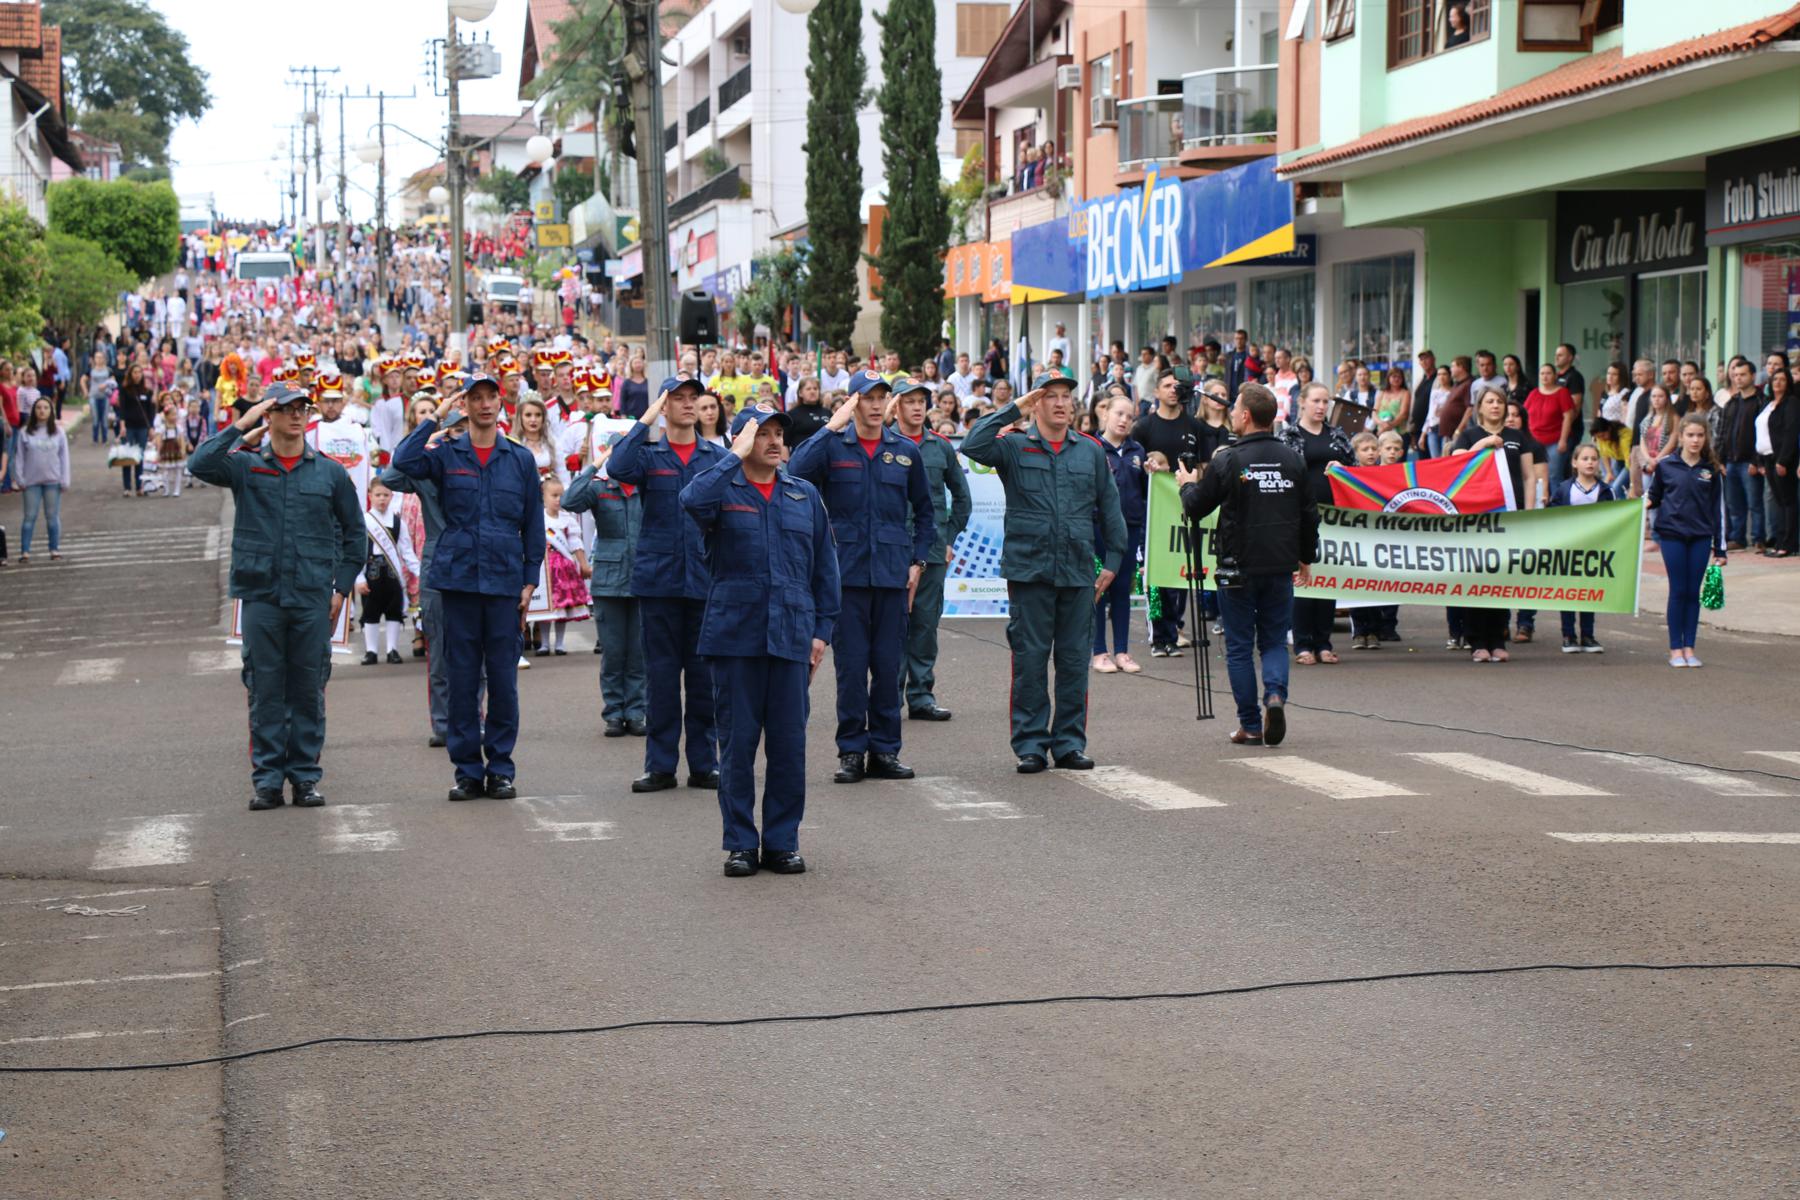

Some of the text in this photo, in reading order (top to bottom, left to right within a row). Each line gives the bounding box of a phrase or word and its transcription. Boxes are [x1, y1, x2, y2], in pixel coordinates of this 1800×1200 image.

[1723, 177, 1755, 224] Foto
[1087, 172, 1182, 291] BECKER
[1570, 207, 1697, 273] Cia da Moda
[1374, 512, 1506, 533] MUNICIPAL
[1374, 542, 1500, 574] CELESTINO
[1507, 547, 1616, 578] FORNECK
[1341, 577, 1448, 596] APRIMORAR
[1450, 583, 1463, 596] A
[1466, 583, 1605, 603] APRENDIZAGEM
